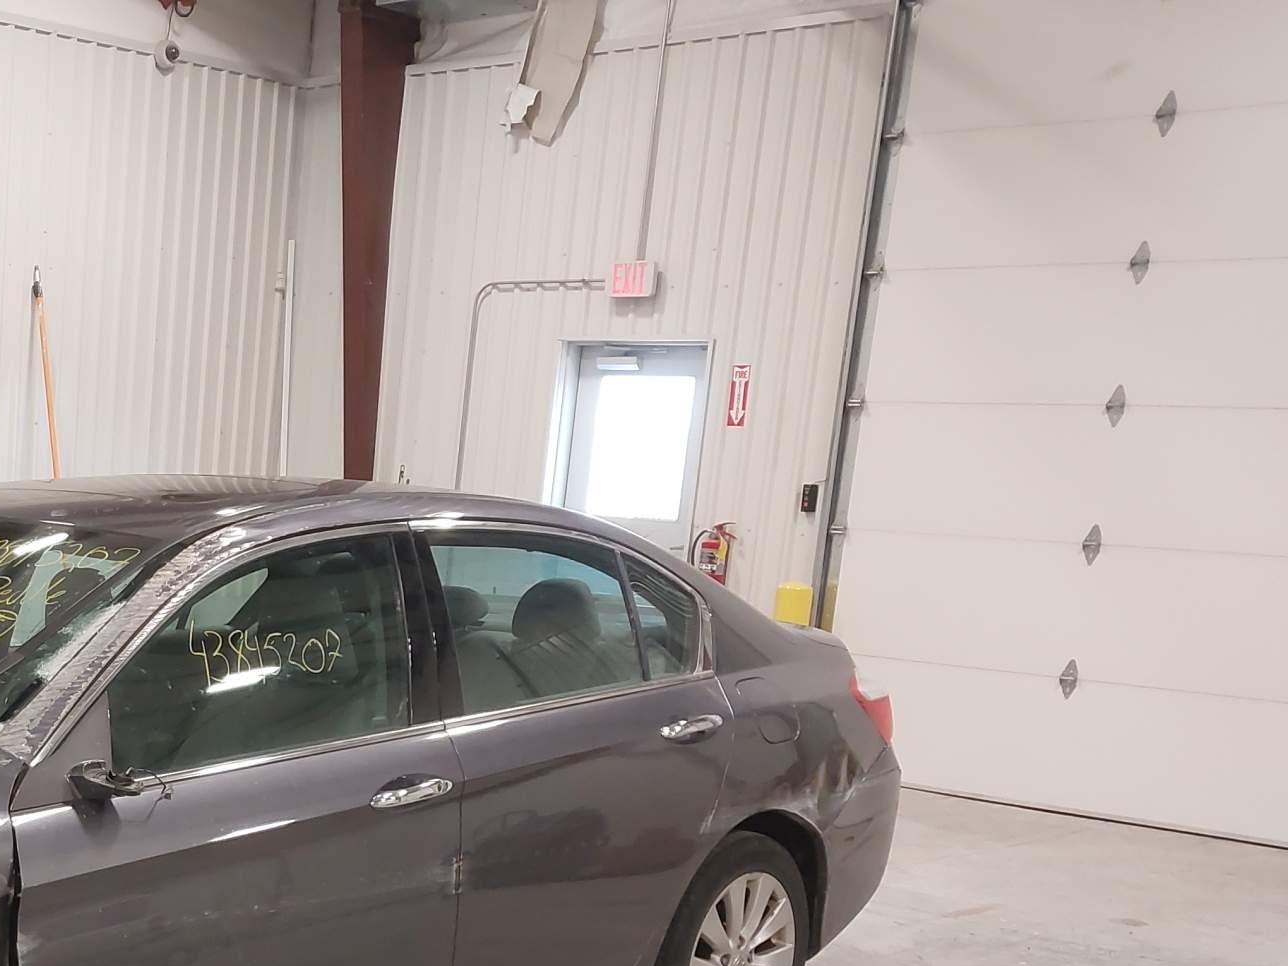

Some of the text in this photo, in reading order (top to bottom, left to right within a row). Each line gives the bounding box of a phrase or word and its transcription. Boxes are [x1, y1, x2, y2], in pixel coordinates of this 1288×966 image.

[613, 263, 647, 294] EXIT
[734, 370, 748, 379] FIRE
[189, 620, 343, 687] 43845207
